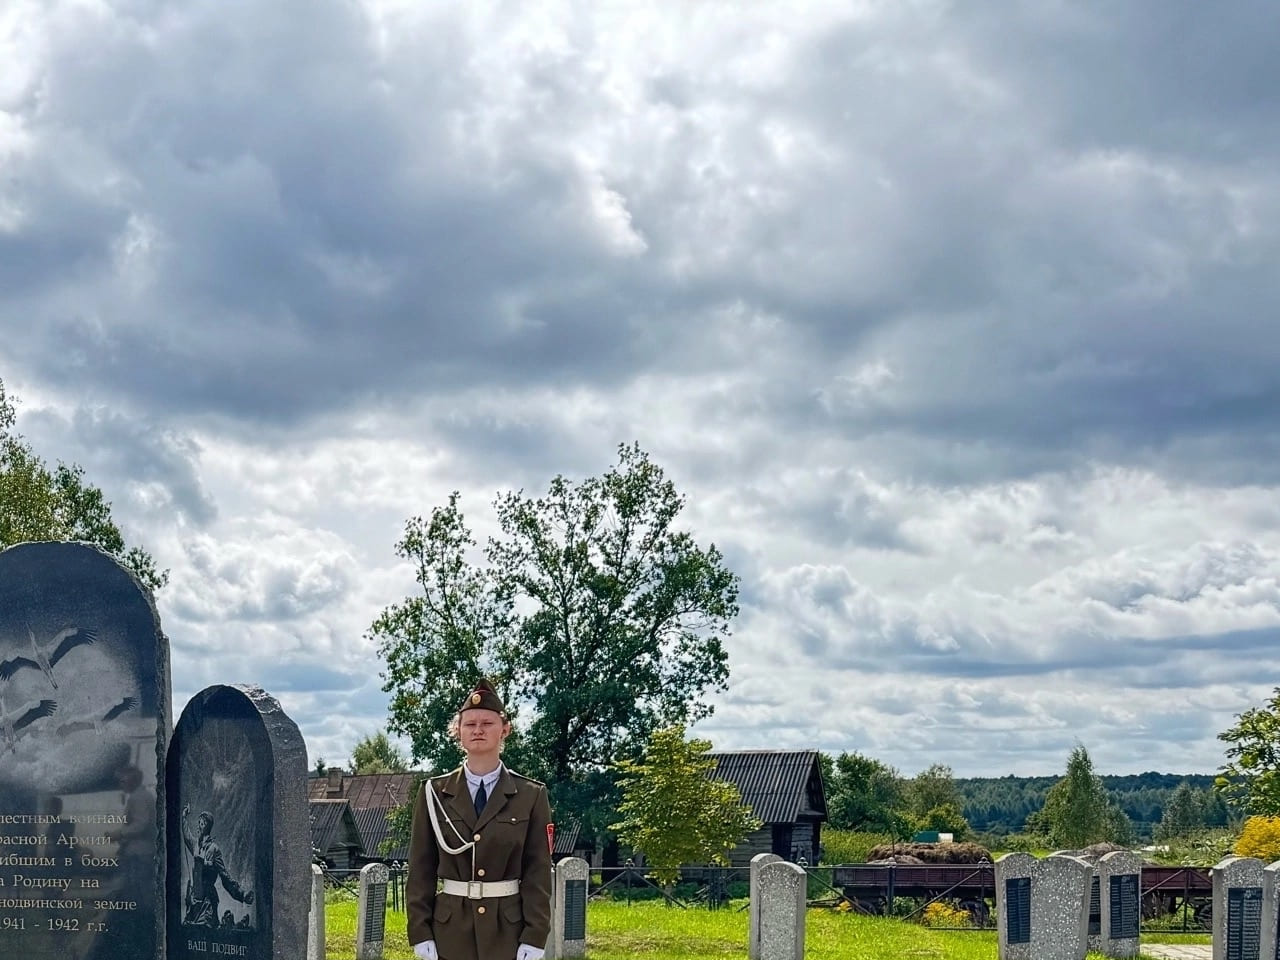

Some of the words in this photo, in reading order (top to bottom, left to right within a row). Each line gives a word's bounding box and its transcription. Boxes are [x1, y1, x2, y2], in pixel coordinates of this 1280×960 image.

[70, 814, 128, 824] воинам
[56, 834, 111, 848] Армии
[64, 858, 72, 866] в
[81, 855, 119, 867] боях
[12, 875, 72, 891] Родину
[80, 879, 100, 888] на
[94, 901, 137, 910] земле
[48, 919, 79, 931] 1942
[87, 923, 109, 932] г.г.
[188, 940, 207, 951] ВАШ
[212, 942, 247, 956] ПОДВИГ
